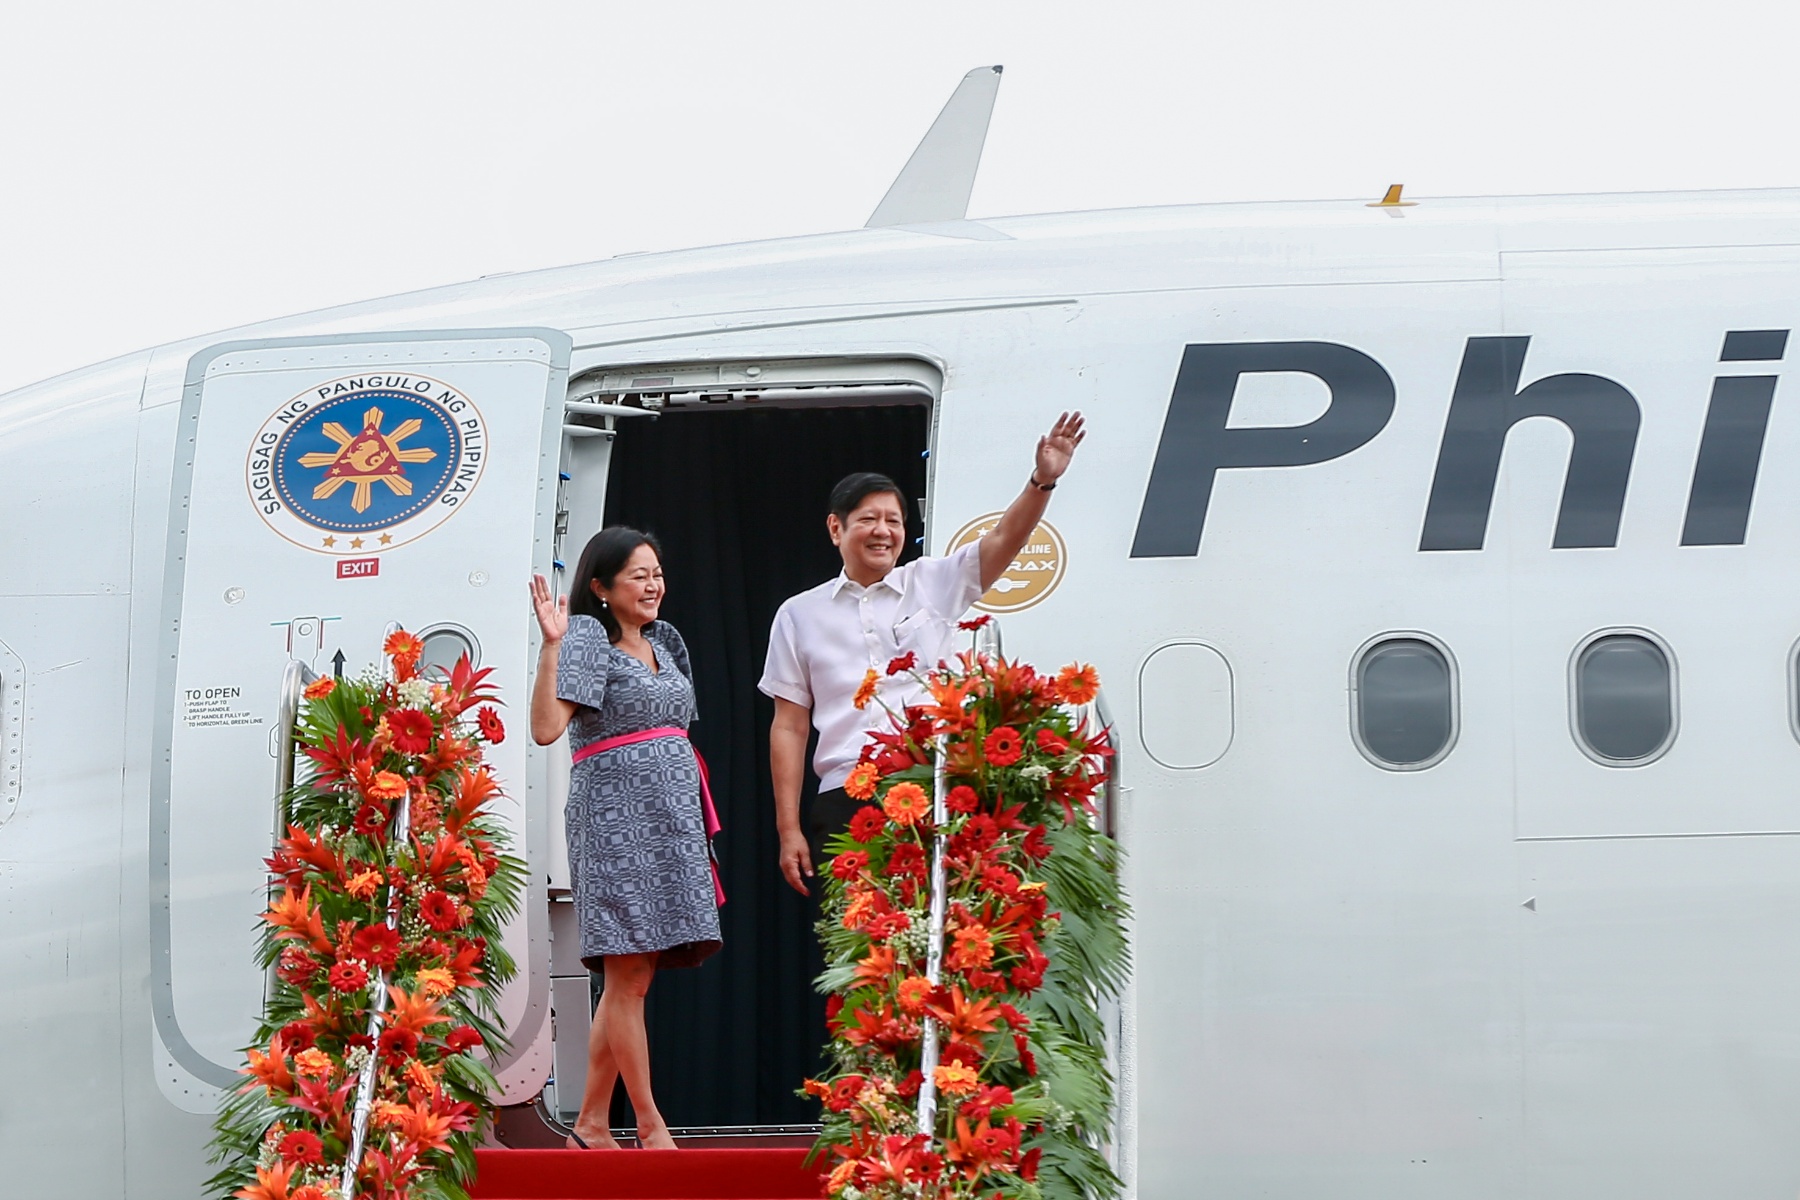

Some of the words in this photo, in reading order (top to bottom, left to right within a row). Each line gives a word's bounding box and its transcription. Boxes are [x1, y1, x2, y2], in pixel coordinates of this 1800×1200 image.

[317, 376, 431, 399] PANGULO
[277, 401, 309, 424] NG
[437, 391, 467, 414] NG
[1129, 329, 1790, 558] Phi
[252, 432, 281, 515] SAGISAG
[441, 418, 481, 507] PILIPINAS
[341, 561, 375, 575] EXIT
[185, 690, 201, 700] TO
[205, 687, 240, 699] OPEN
